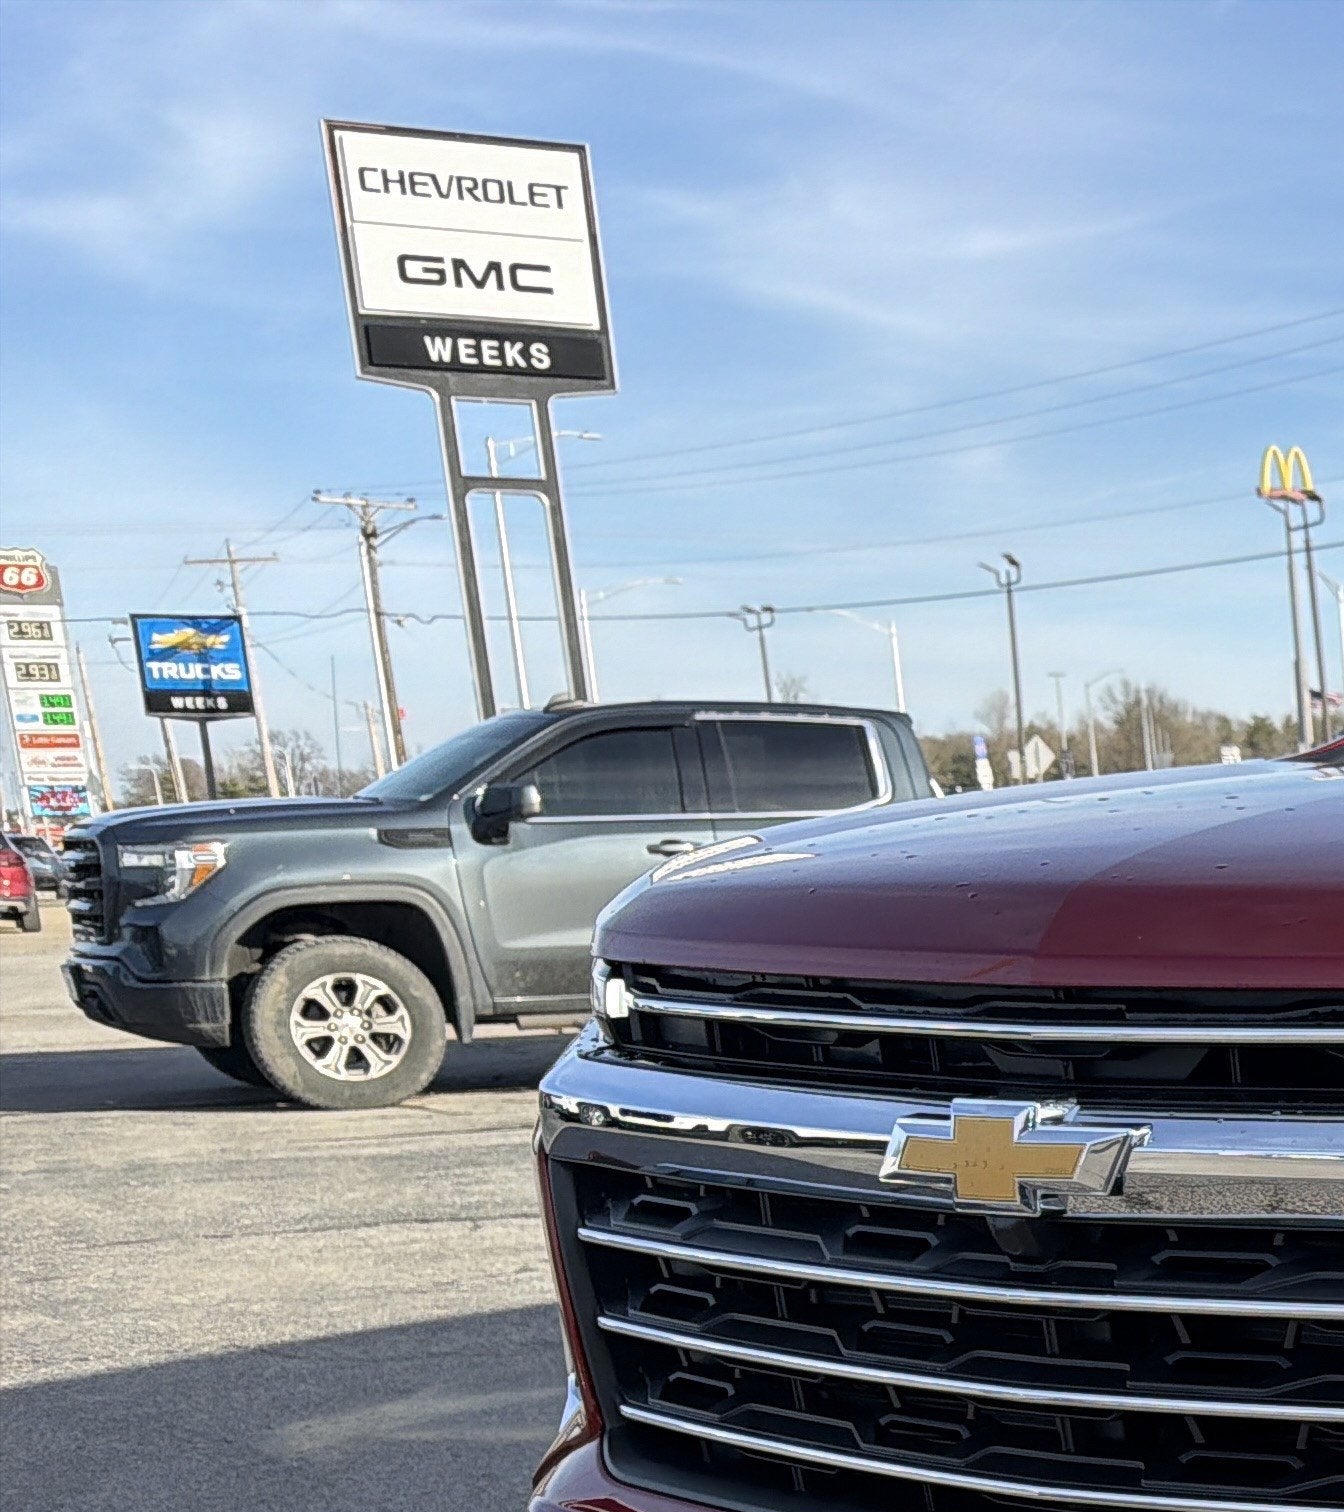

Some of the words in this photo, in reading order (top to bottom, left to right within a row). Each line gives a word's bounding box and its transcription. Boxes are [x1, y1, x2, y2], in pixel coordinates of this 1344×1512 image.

[358, 166, 568, 210] CHEVROLET
[397, 253, 555, 296] GMC
[423, 334, 552, 371] WEEKS
[2, 566, 38, 587] 66
[145, 661, 242, 680] TRUCKS
[170, 695, 229, 710] WEEKS
